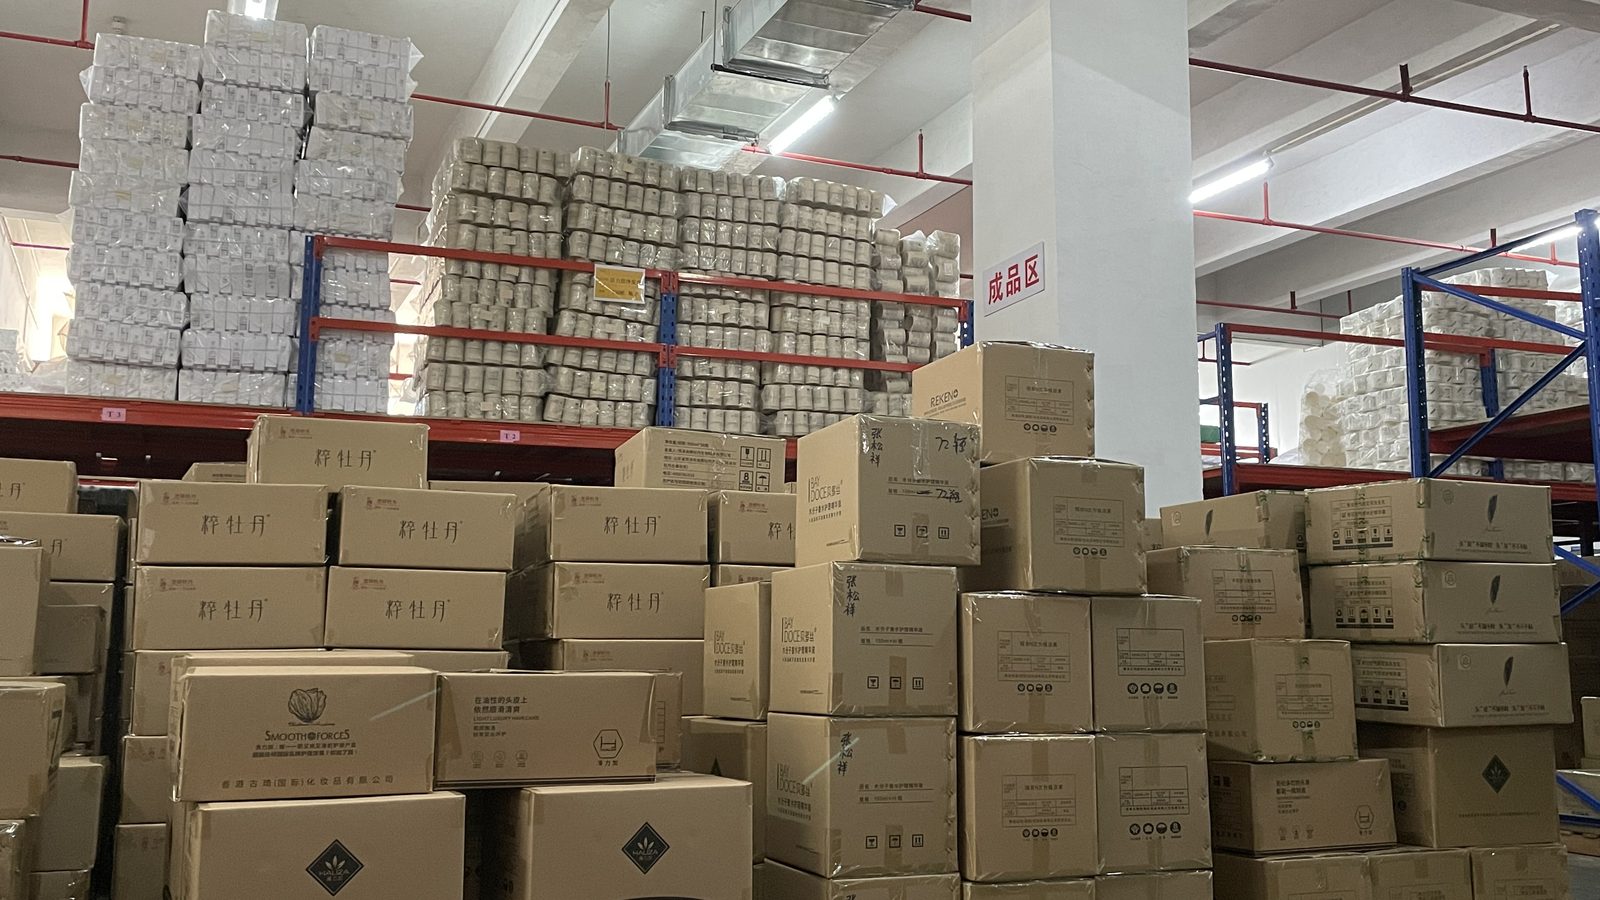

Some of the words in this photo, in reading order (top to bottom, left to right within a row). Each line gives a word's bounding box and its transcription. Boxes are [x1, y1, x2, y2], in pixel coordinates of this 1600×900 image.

[988, 254, 1040, 305] 成品区
[264, 730, 307, 742] SMOOTH
